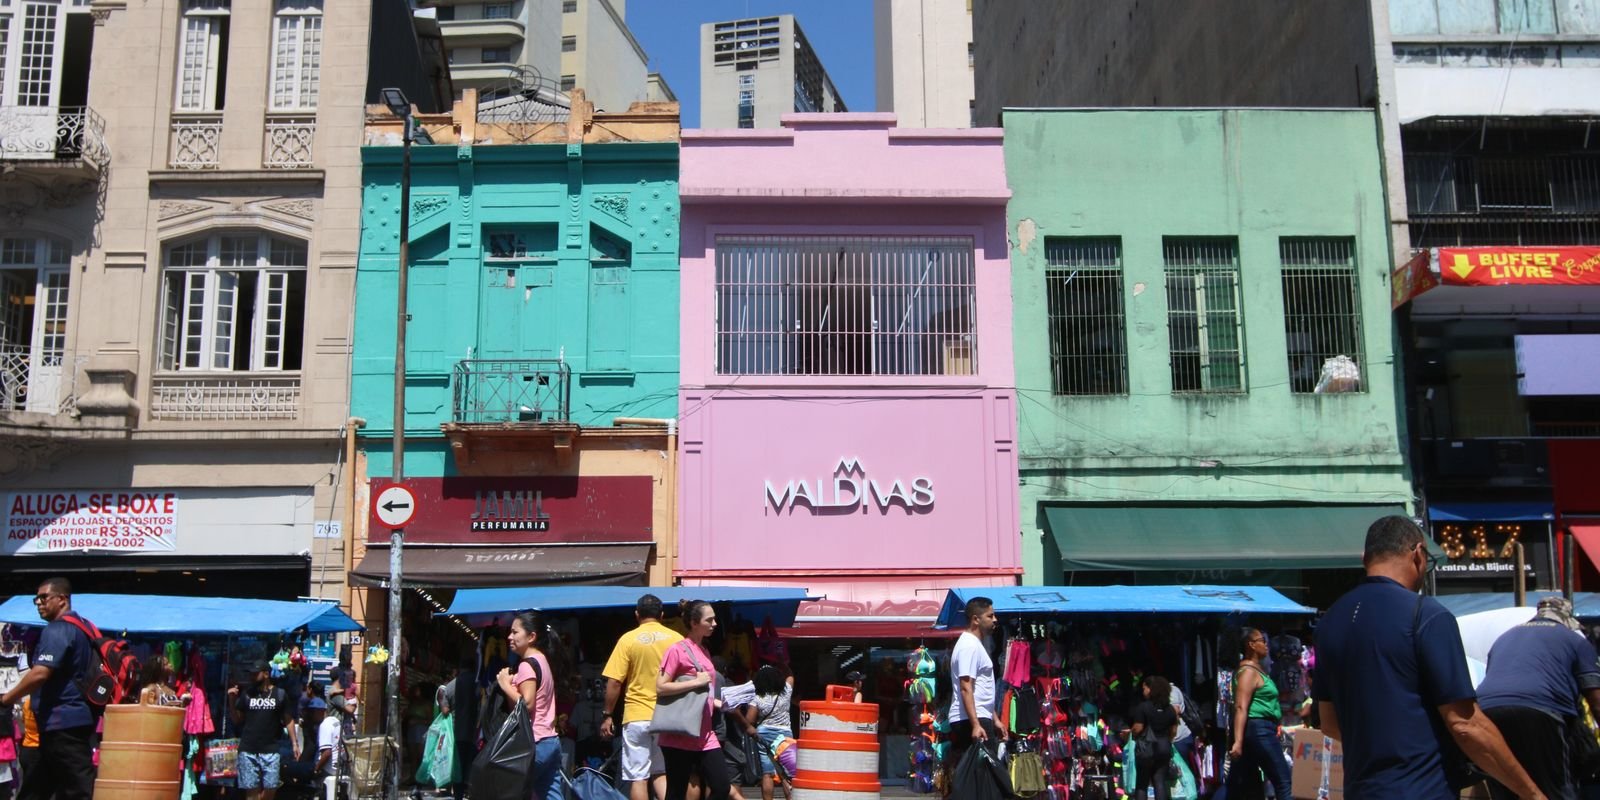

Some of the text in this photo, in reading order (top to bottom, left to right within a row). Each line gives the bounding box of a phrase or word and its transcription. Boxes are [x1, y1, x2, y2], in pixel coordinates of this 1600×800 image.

[1479, 253, 1560, 266] BUFFET
[1490, 265, 1554, 279] LIVRE
[764, 477, 936, 516] MALDIVAS
[10, 493, 175, 515] ALUGA-SE BOX E
[470, 490, 550, 519] JAMIL
[60, 517, 70, 526] P/
[72, 517, 105, 526] LOJAS
[106, 517, 113, 525] E
[472, 521, 546, 530] PERFUMARIA
[8, 529, 41, 540] AQUI
[51, 528, 84, 536] PARTIR
[85, 528, 98, 536] DE
[100, 526, 118, 537] R$
[316, 523, 339, 535] 795
[48, 537, 145, 549] (11) 98942-0002
[1440, 524, 1521, 559] 817
[1468, 562, 1485, 571] das
[1486, 562, 1532, 572] Bijuteas
[249, 698, 276, 707] BOSS
